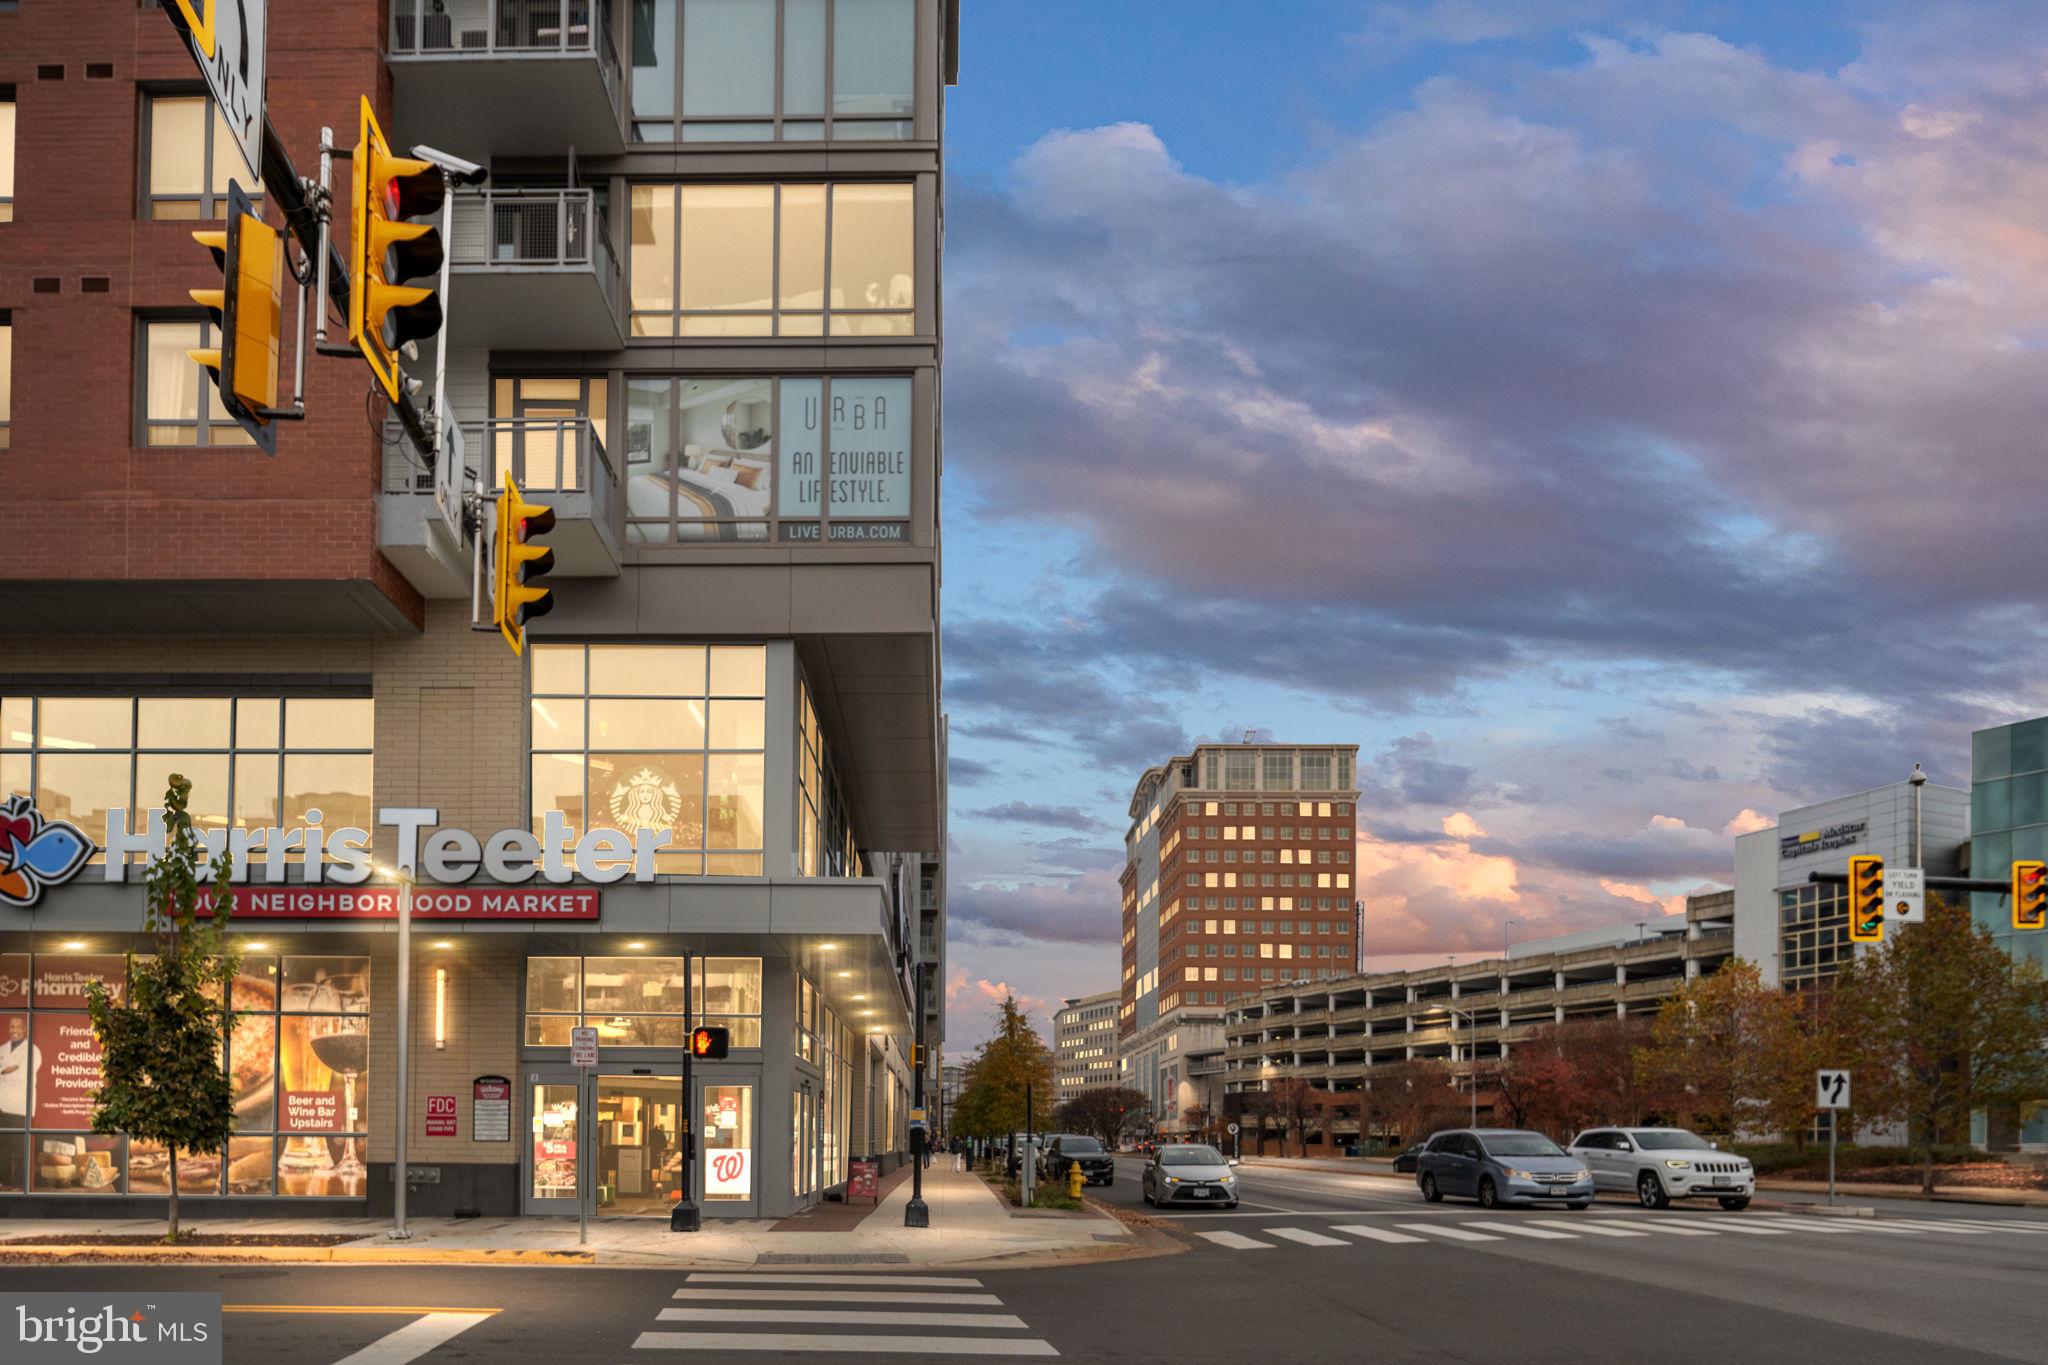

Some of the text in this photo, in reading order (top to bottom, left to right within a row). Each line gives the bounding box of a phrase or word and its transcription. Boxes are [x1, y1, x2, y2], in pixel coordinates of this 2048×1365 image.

[805, 396, 886, 430] URBA
[793, 451, 904, 475] AN ENVIABLE
[800, 480, 890, 503] LIFESTYLE.
[105, 807, 672, 884] Harris Teeter
[1892, 881, 1915, 889] YIELD
[483, 895, 593, 912] MARKET
[44, 972, 71, 982] Harris
[21, 978, 122, 1000] Pharmcy
[60, 1025, 96, 1036] Friend
[70, 1040, 91, 1050] and
[58, 1052, 102, 1062] Credible
[51, 1065, 98, 1075] Healthca
[55, 1078, 105, 1088] Providers
[288, 1095, 336, 1105] Beer and
[429, 1098, 455, 1113] FDC
[288, 1106, 336, 1116] Wine Bar
[290, 1117, 333, 1130] Upstairs
